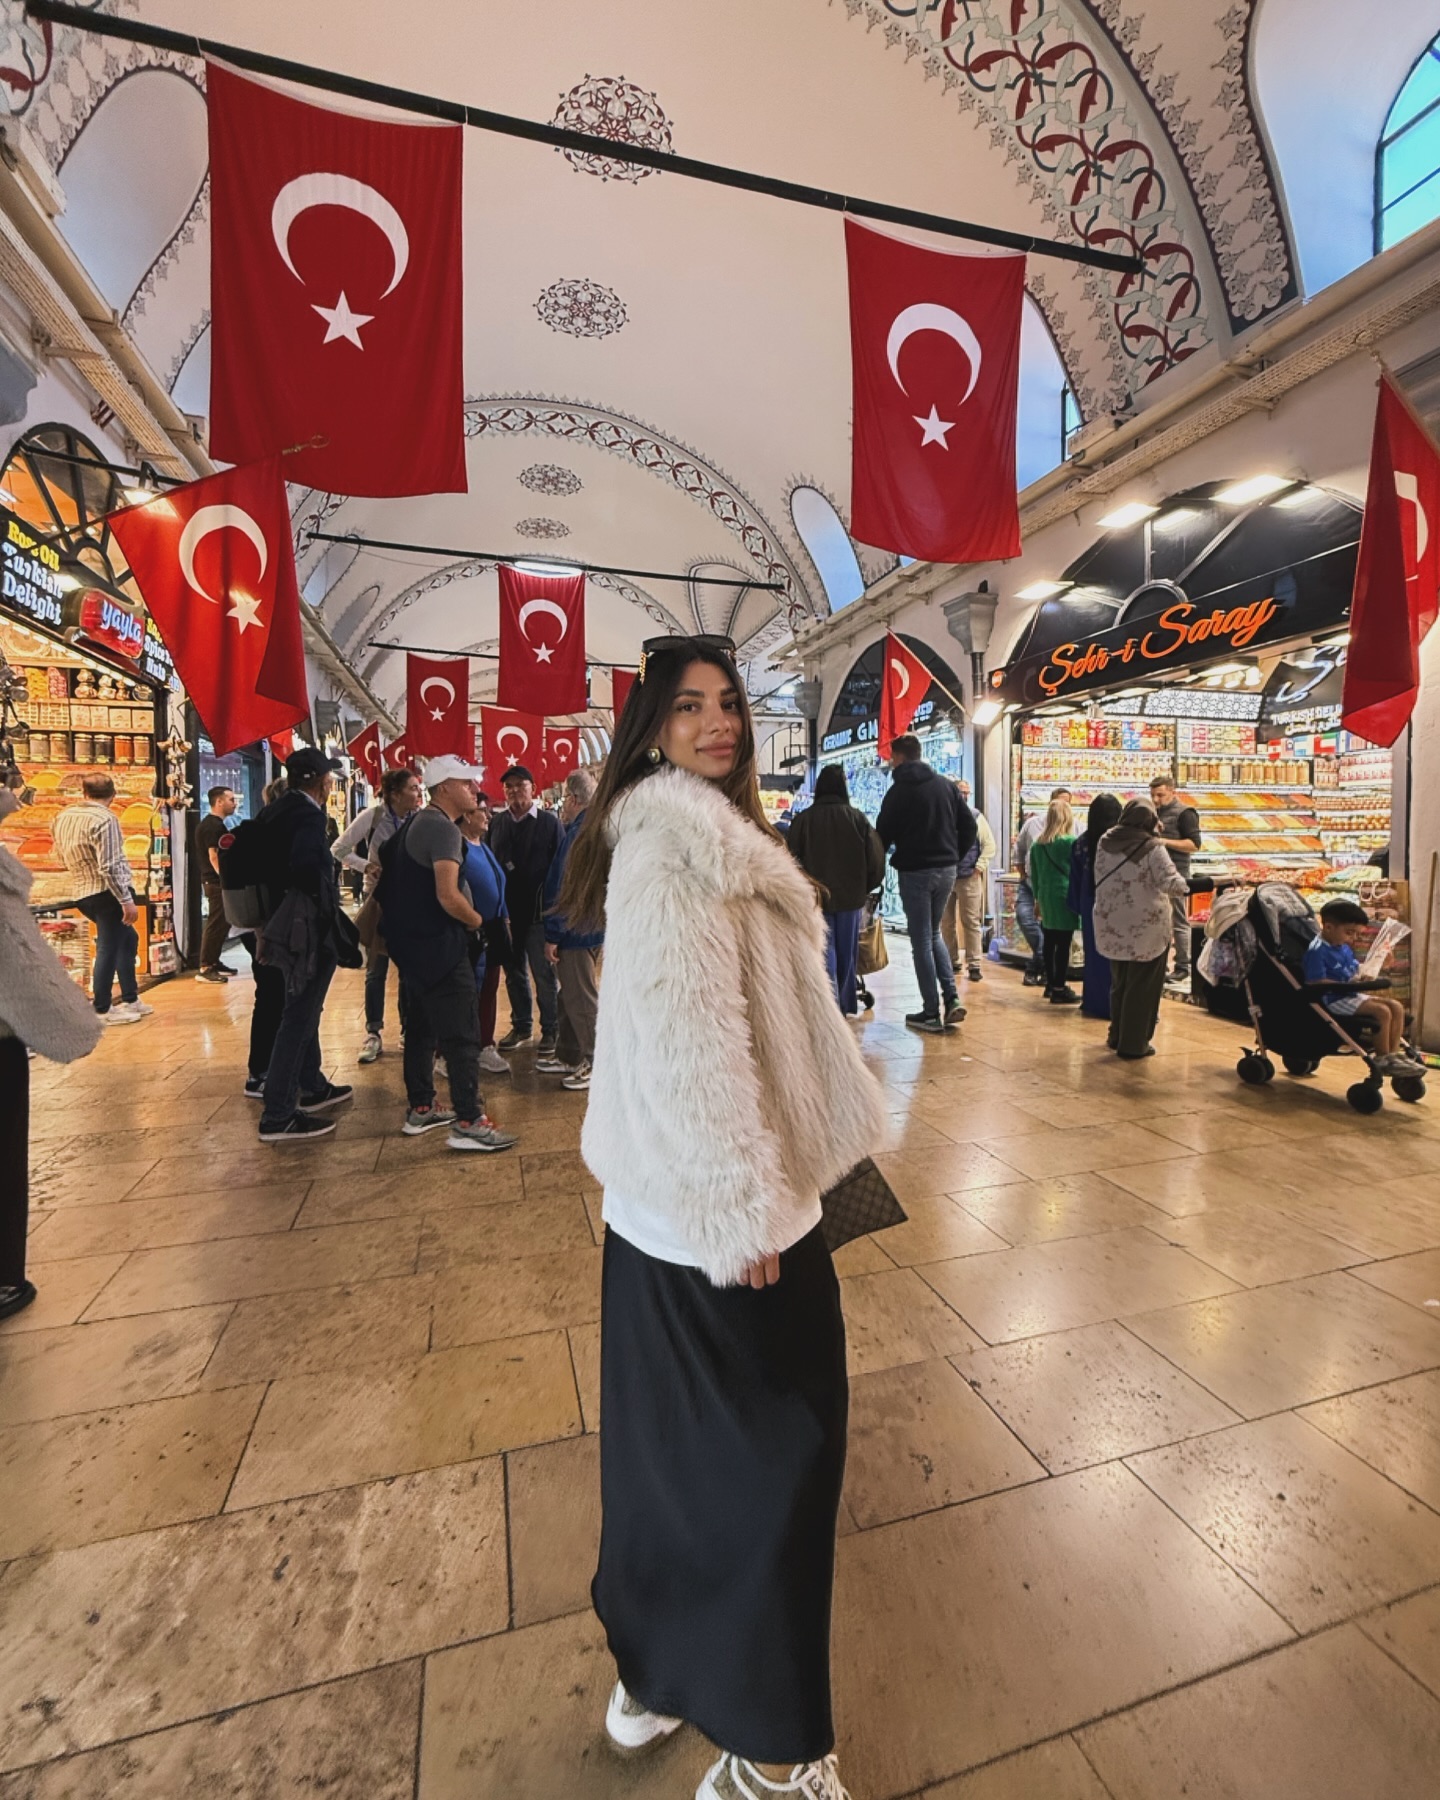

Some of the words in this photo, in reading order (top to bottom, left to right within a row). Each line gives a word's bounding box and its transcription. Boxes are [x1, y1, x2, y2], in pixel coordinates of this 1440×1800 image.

[2, 570, 62, 626] Delight
[100, 599, 142, 643] yayla
[1141, 597, 1277, 658] Saray
[1315, 704, 1343, 720] DELI
